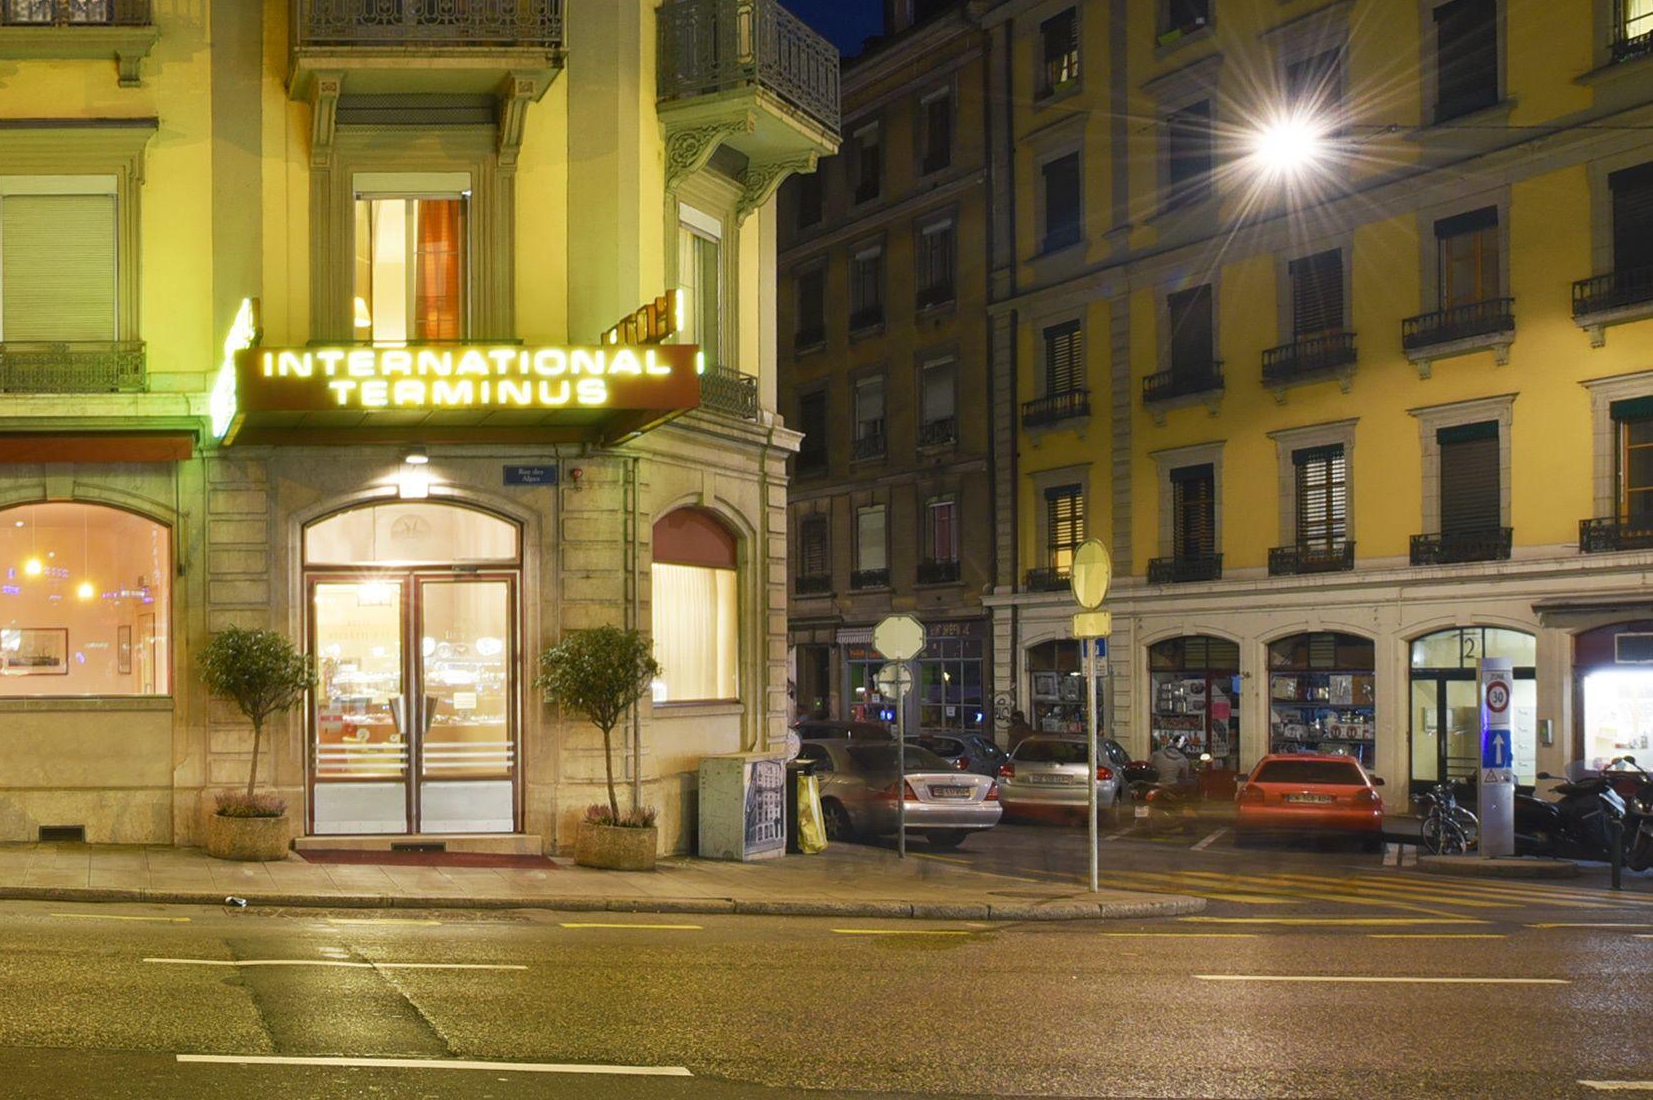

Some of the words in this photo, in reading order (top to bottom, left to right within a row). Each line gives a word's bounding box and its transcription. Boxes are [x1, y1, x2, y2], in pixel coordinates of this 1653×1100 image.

[263, 349, 671, 377] INTERNATIONAL
[328, 379, 609, 406] TERMINUS
[518, 467, 531, 475] Rue
[532, 467, 544, 475] des
[521, 475, 541, 484] Alpes
[1464, 637, 1475, 659] 2
[1492, 691, 1504, 703] 30
